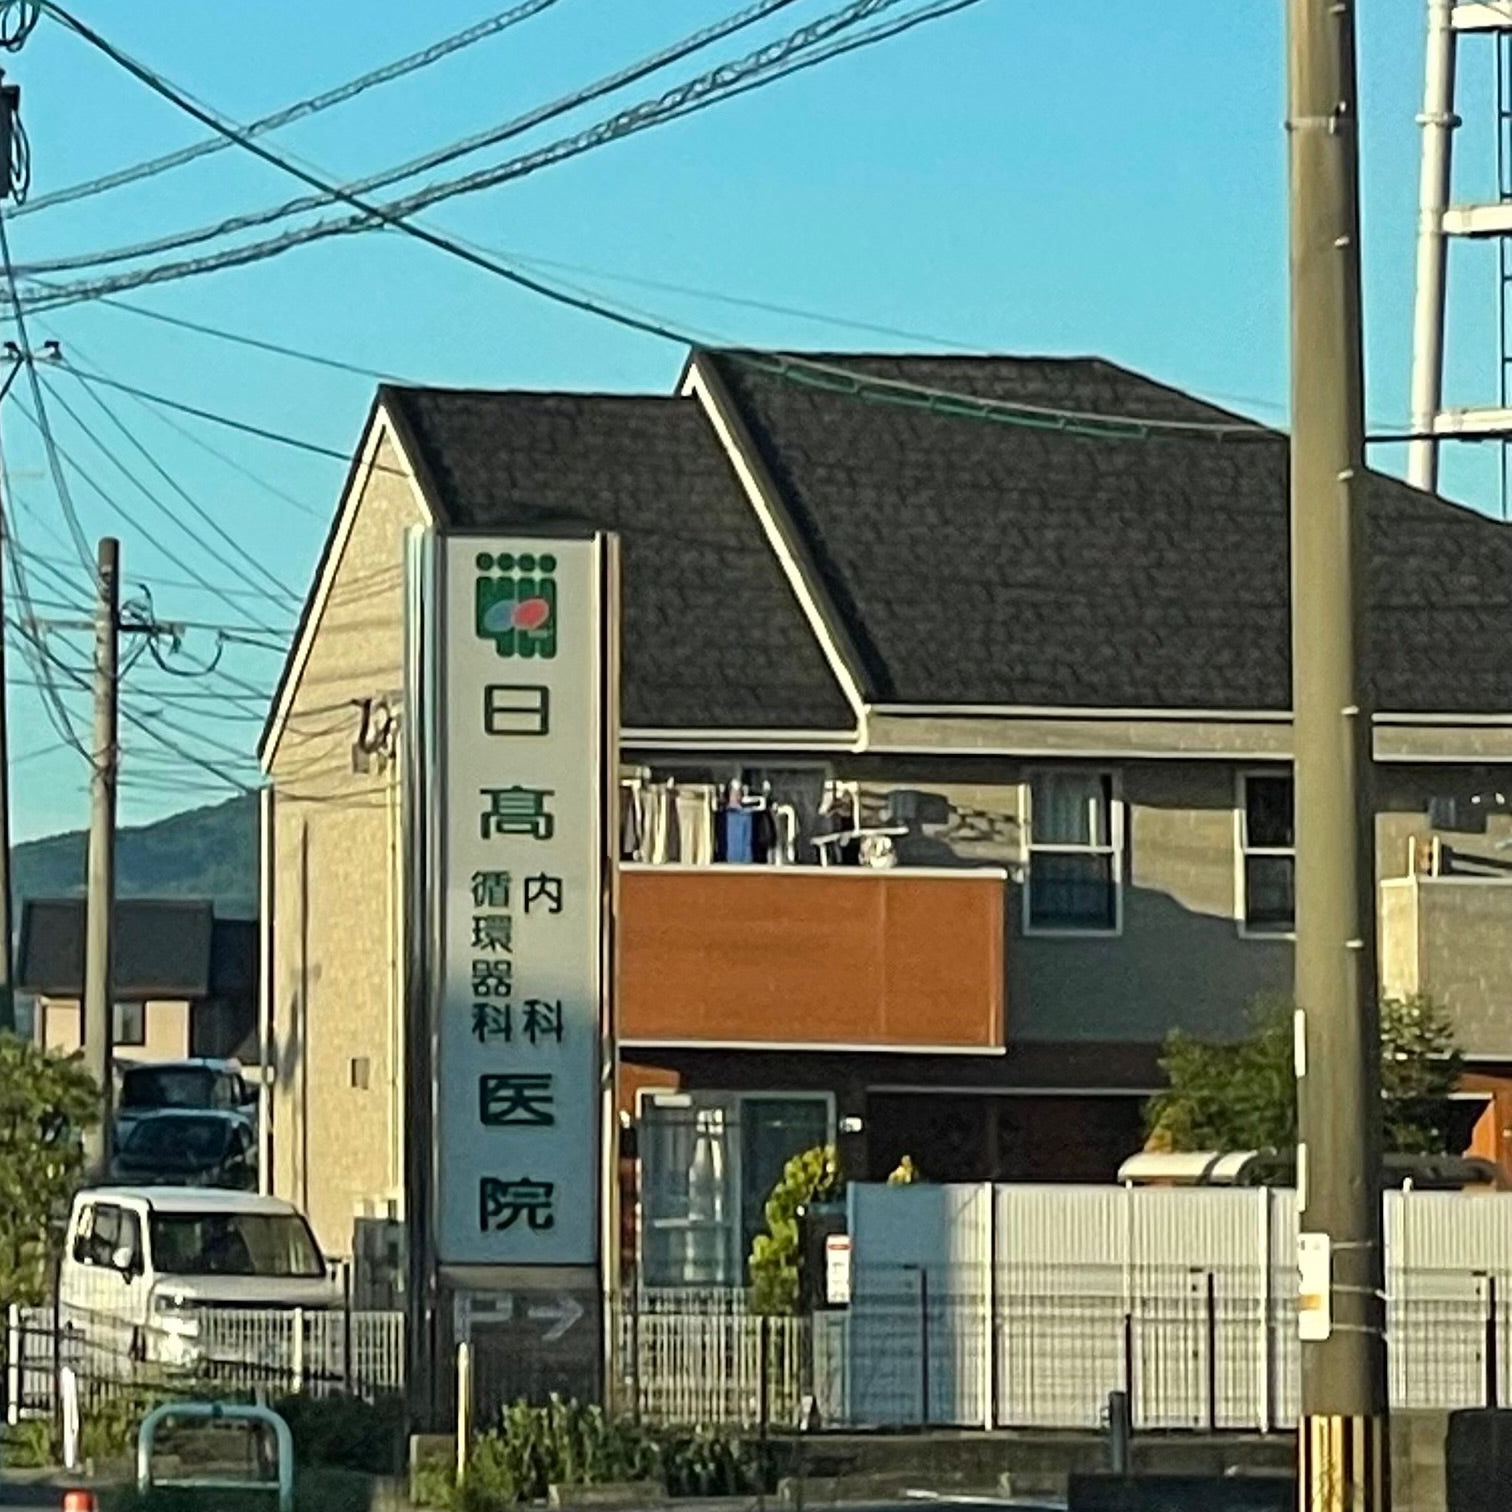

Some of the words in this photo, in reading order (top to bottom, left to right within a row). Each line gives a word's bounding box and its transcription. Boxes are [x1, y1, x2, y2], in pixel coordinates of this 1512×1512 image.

[471, 871, 513, 1044] 循環器科
[454, 1291, 513, 1344] P
